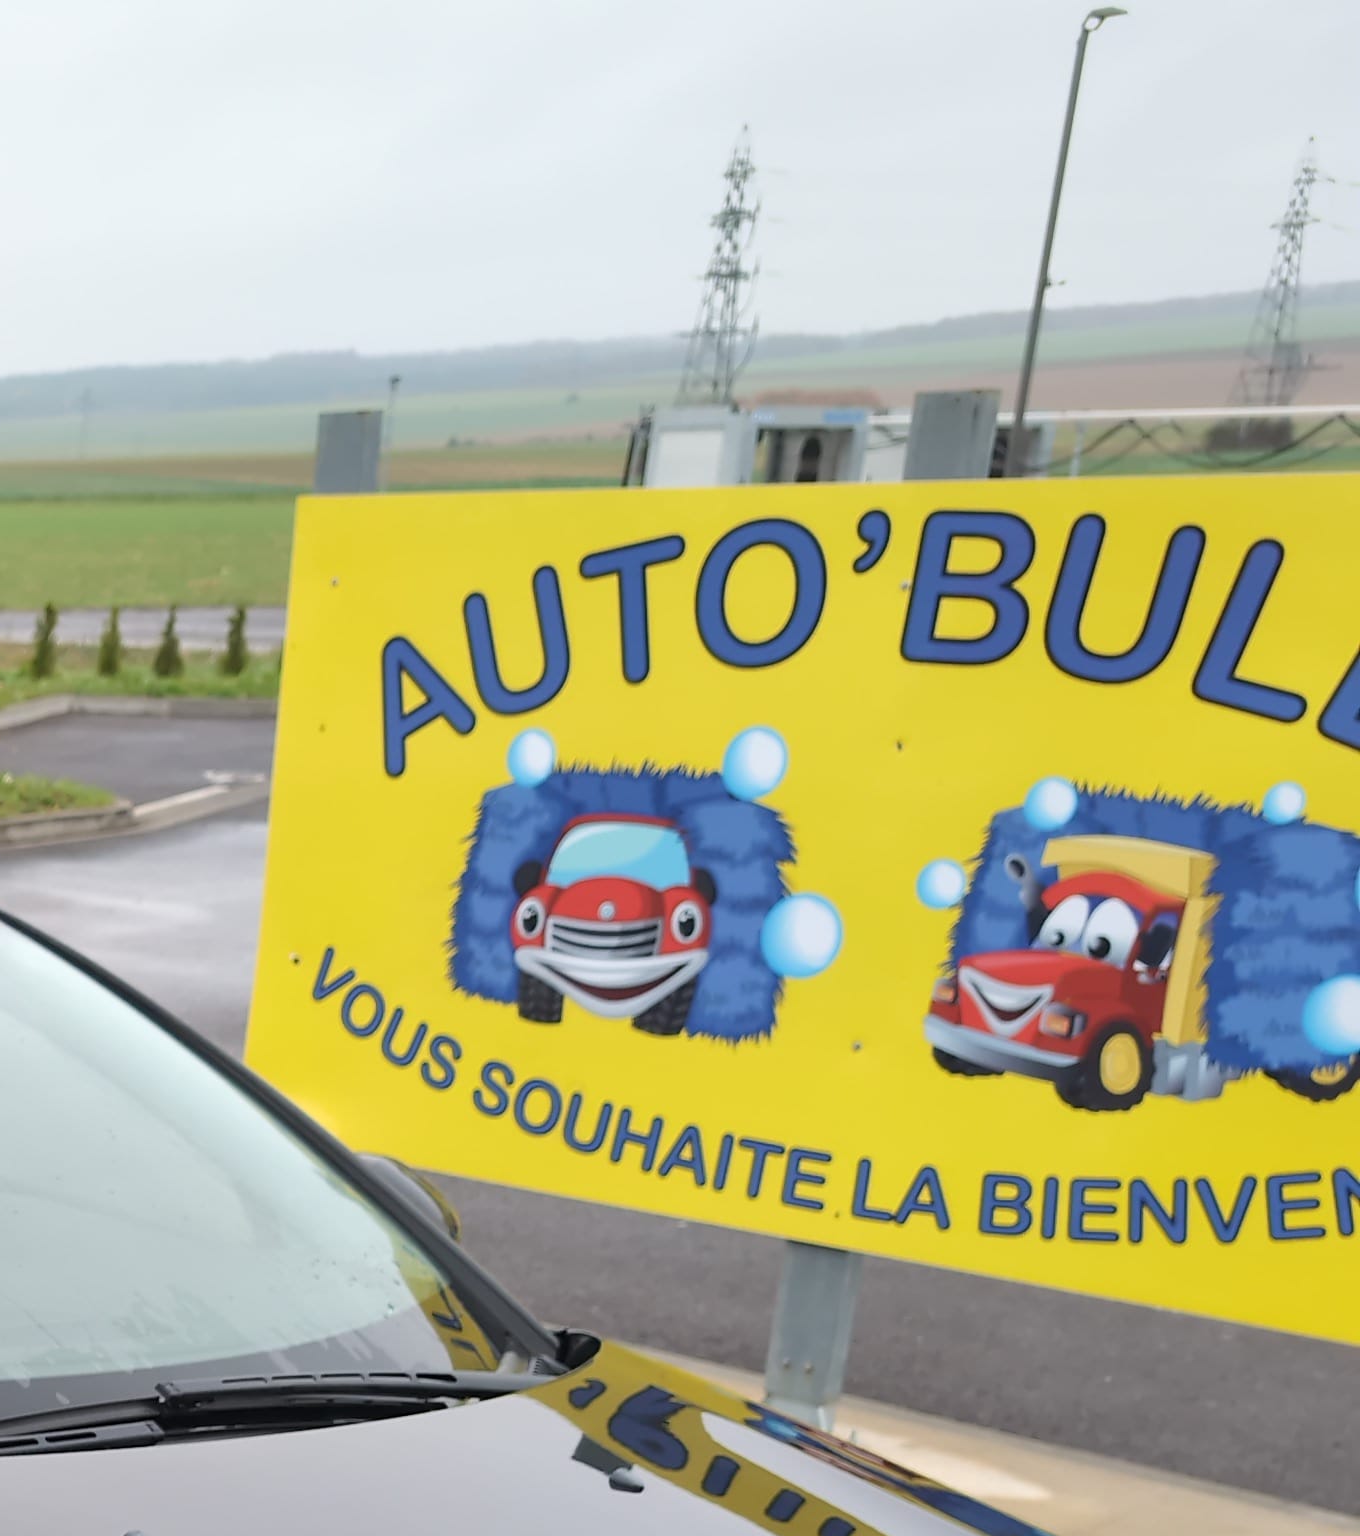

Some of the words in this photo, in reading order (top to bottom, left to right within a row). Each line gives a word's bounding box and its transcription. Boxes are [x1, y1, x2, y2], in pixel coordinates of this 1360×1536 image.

[312, 947, 462, 1090] VOUS
[472, 1061, 833, 1211] SOUHAITE
[851, 1158, 951, 1231] LA
